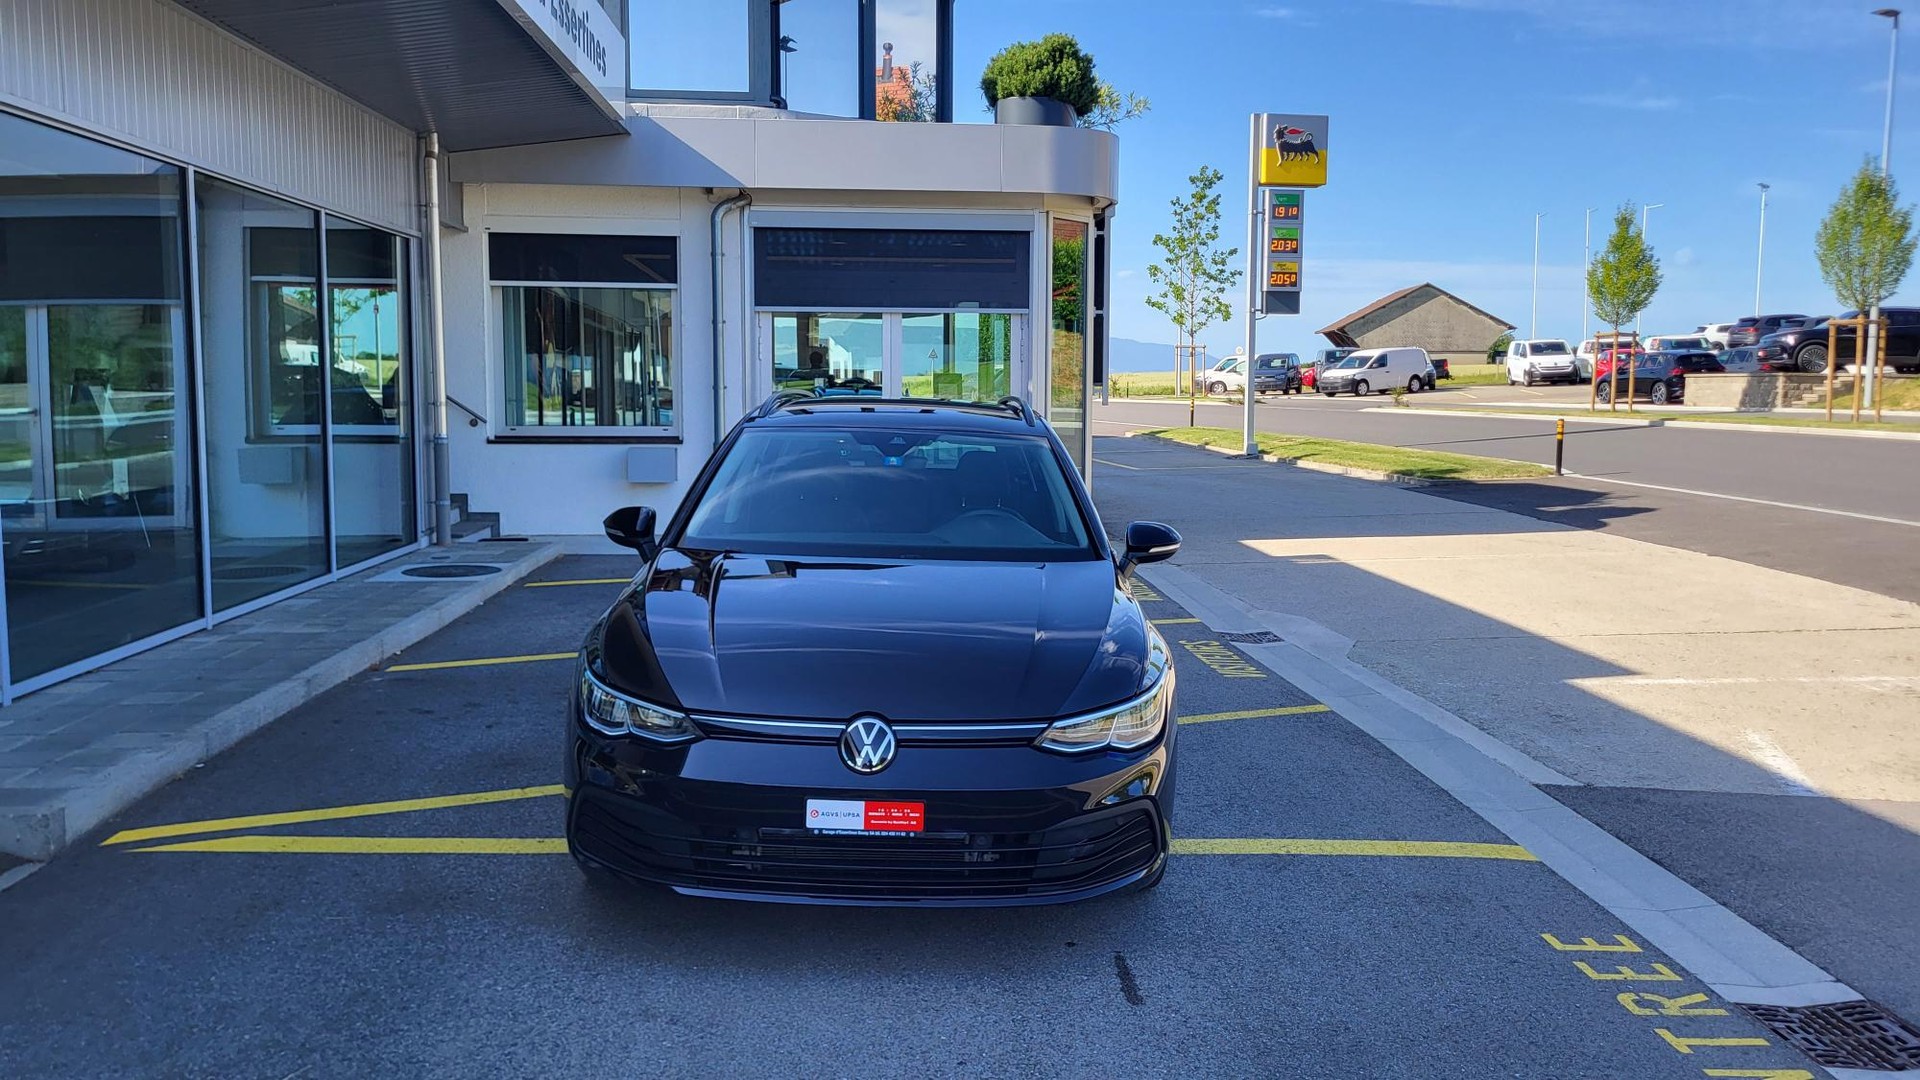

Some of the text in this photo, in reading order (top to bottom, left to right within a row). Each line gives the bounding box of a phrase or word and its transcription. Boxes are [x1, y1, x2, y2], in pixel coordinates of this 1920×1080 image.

[539, 0, 607, 78] ssertines
[1271, 240, 1297, 251] 2.030
[1270, 273, 1296, 285] 2.050
